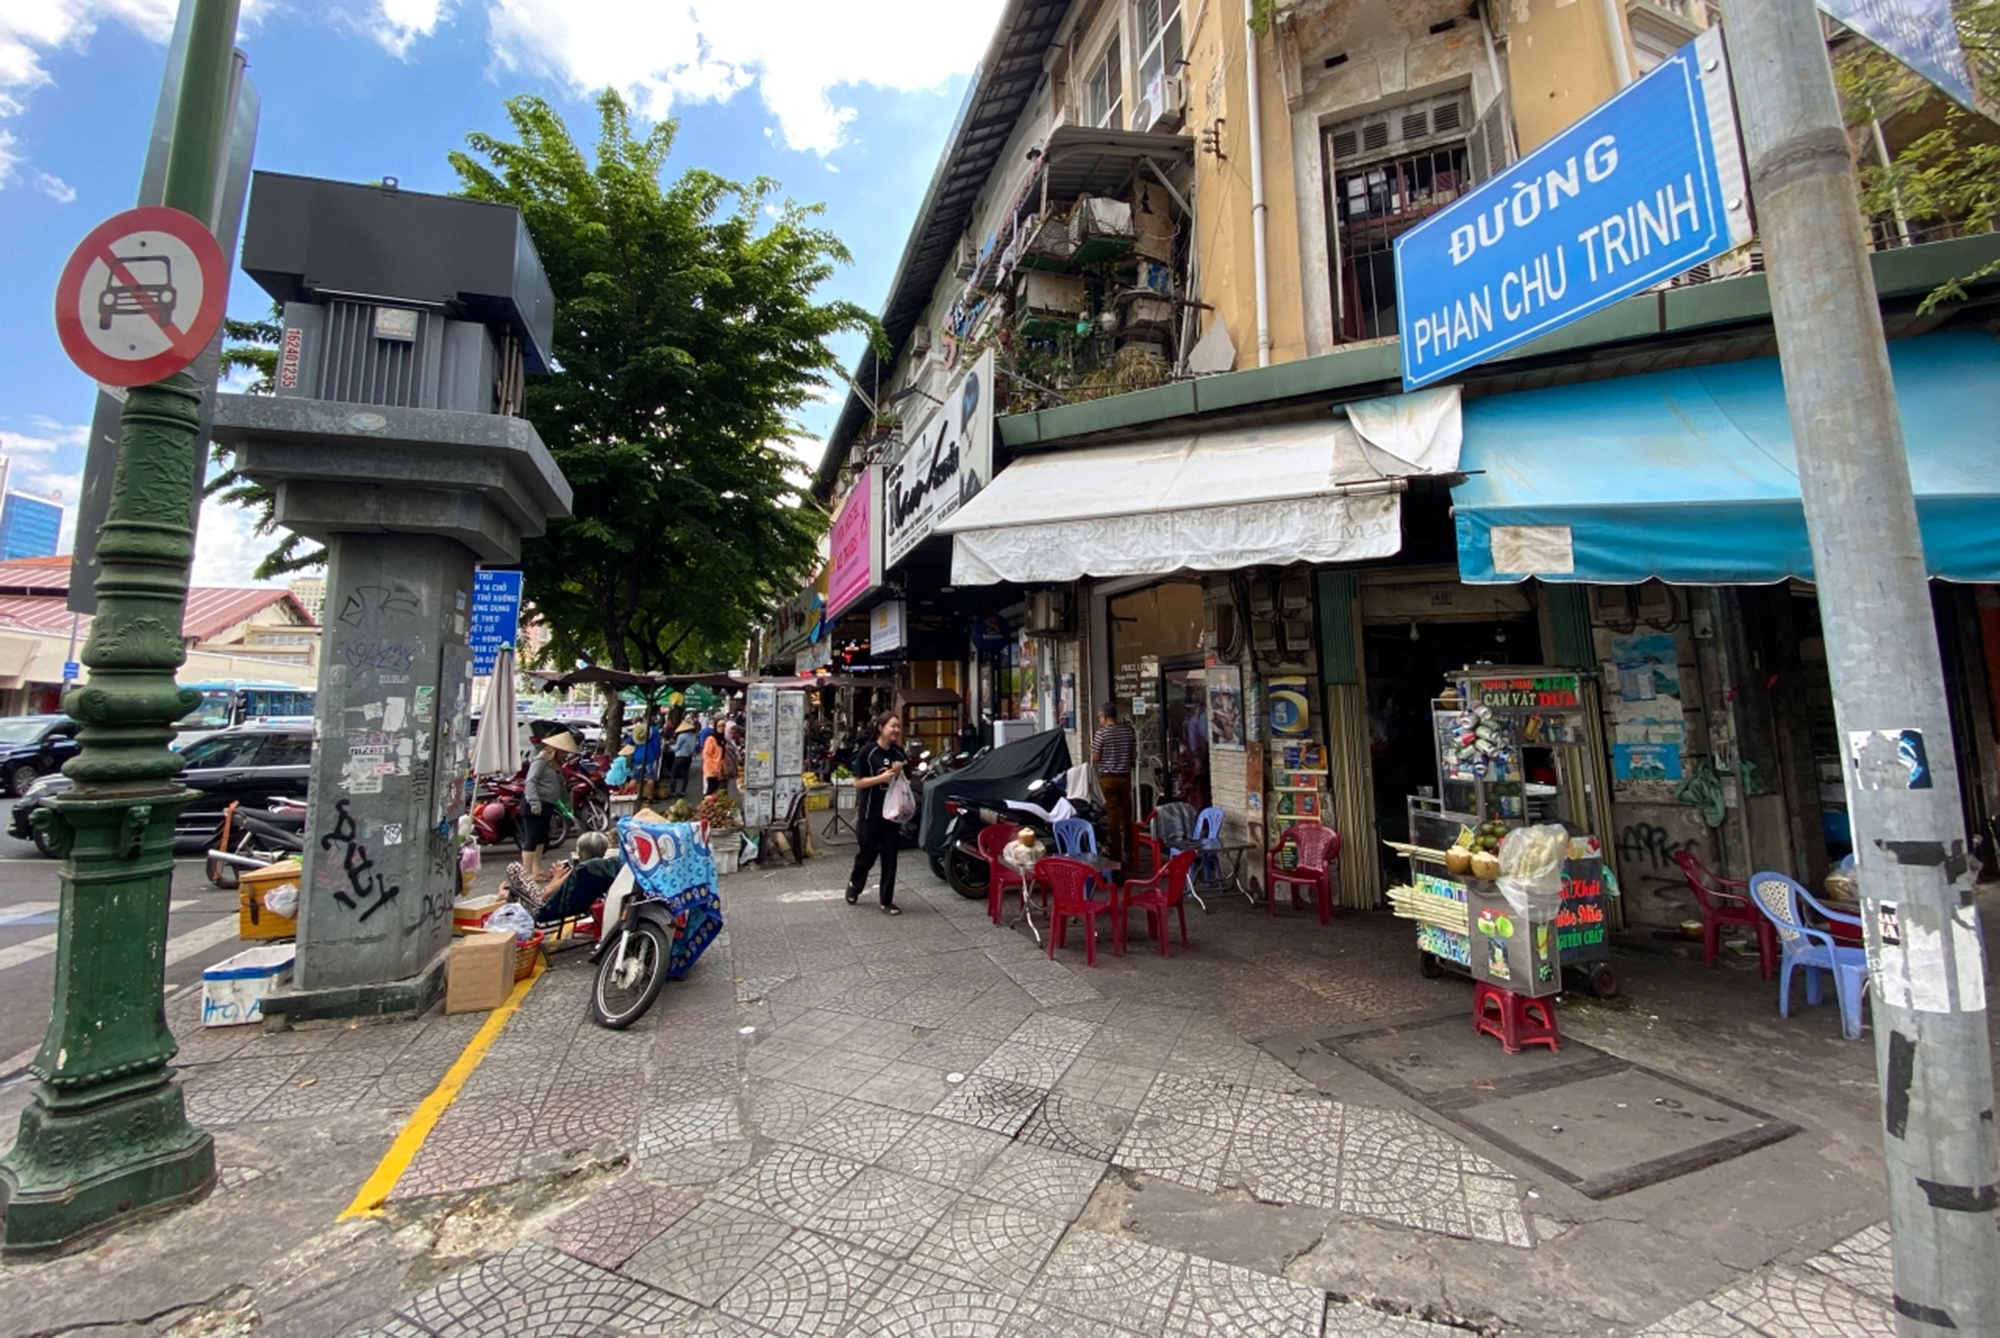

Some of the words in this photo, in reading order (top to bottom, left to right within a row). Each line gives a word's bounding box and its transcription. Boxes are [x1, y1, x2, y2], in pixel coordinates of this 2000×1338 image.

[1448, 134, 1619, 267] ĐƯỜNG
[1414, 284, 1494, 365] PHAN
[1501, 244, 1567, 322] CHU
[1577, 173, 1700, 283] TRINH
[1484, 692, 1510, 706] CAM
